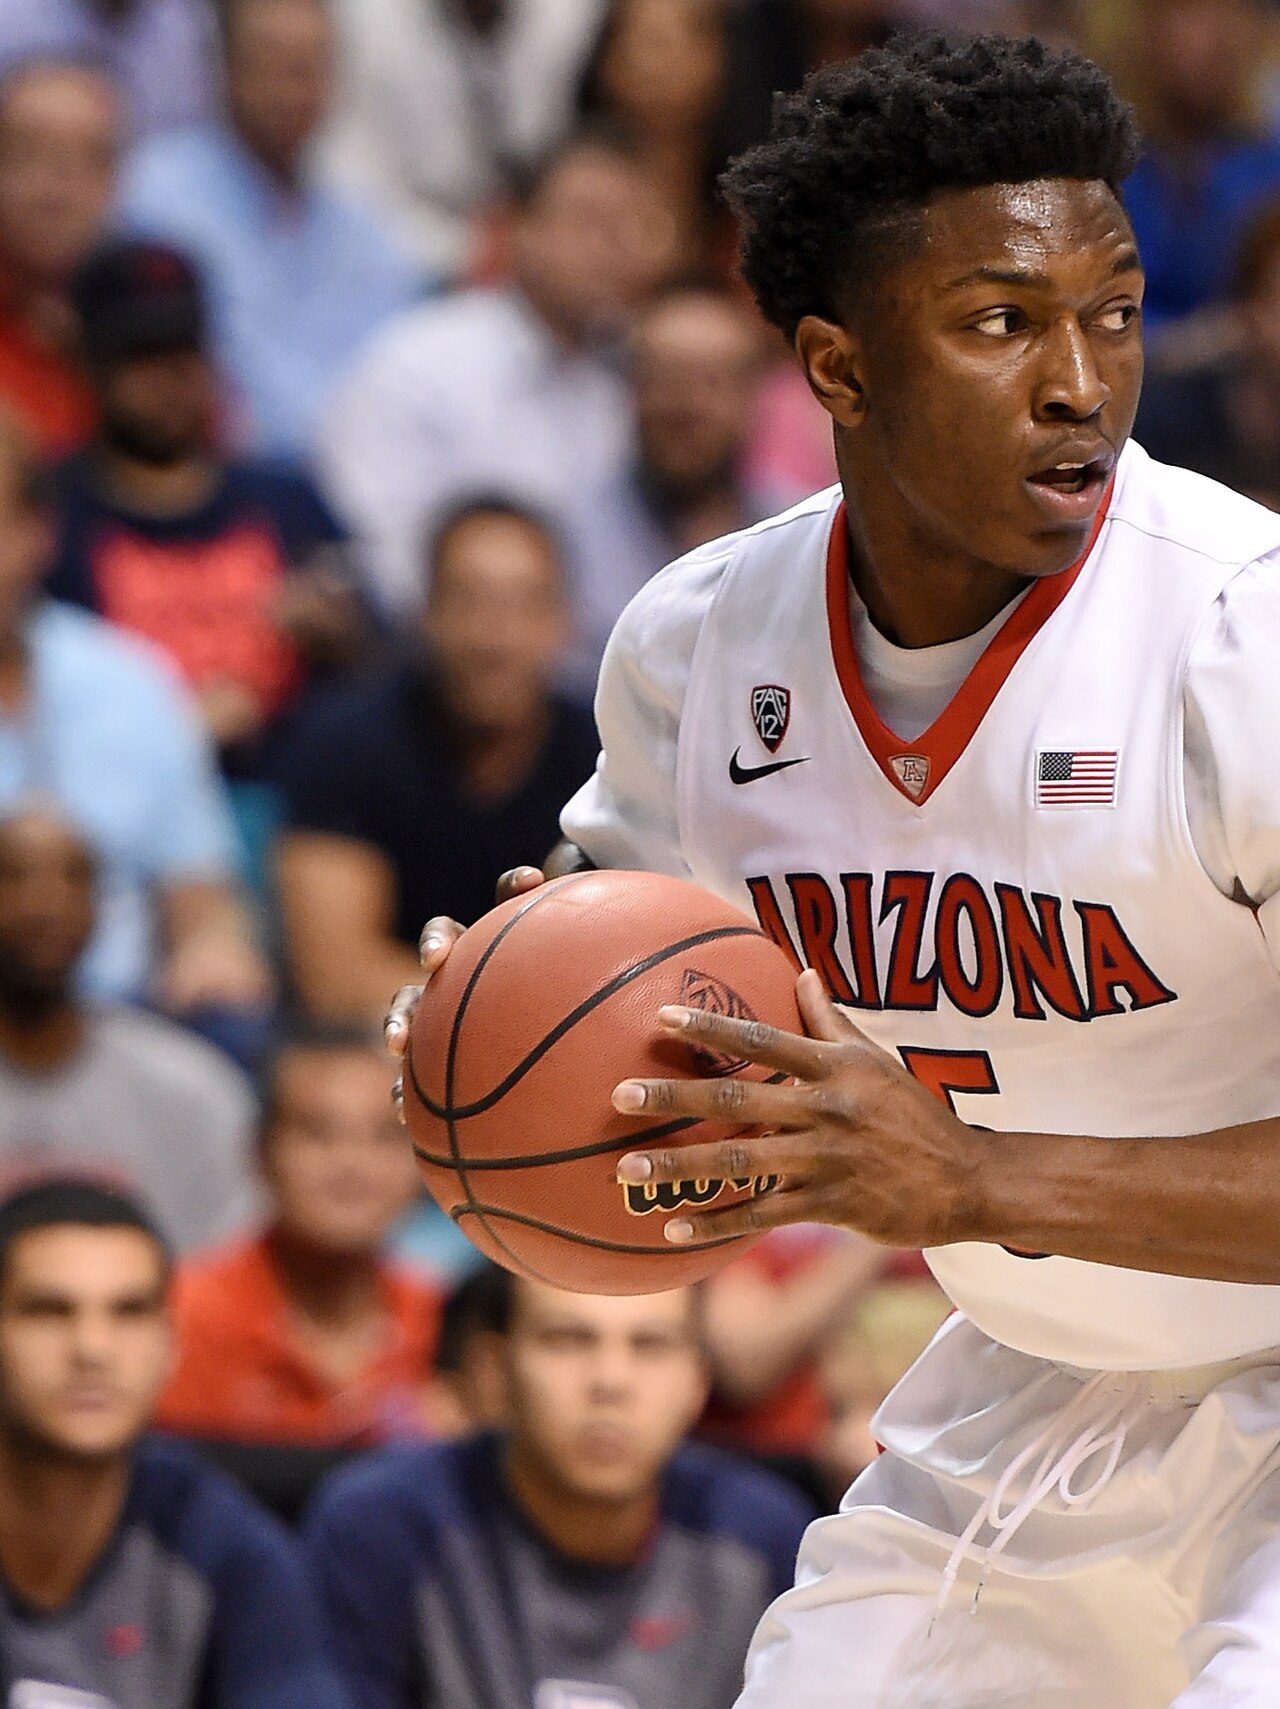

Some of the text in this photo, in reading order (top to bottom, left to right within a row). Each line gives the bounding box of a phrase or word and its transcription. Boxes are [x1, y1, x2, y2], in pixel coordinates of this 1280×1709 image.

[754, 687, 787, 727] PAC
[760, 714, 780, 739] 12
[902, 759, 923, 782] A
